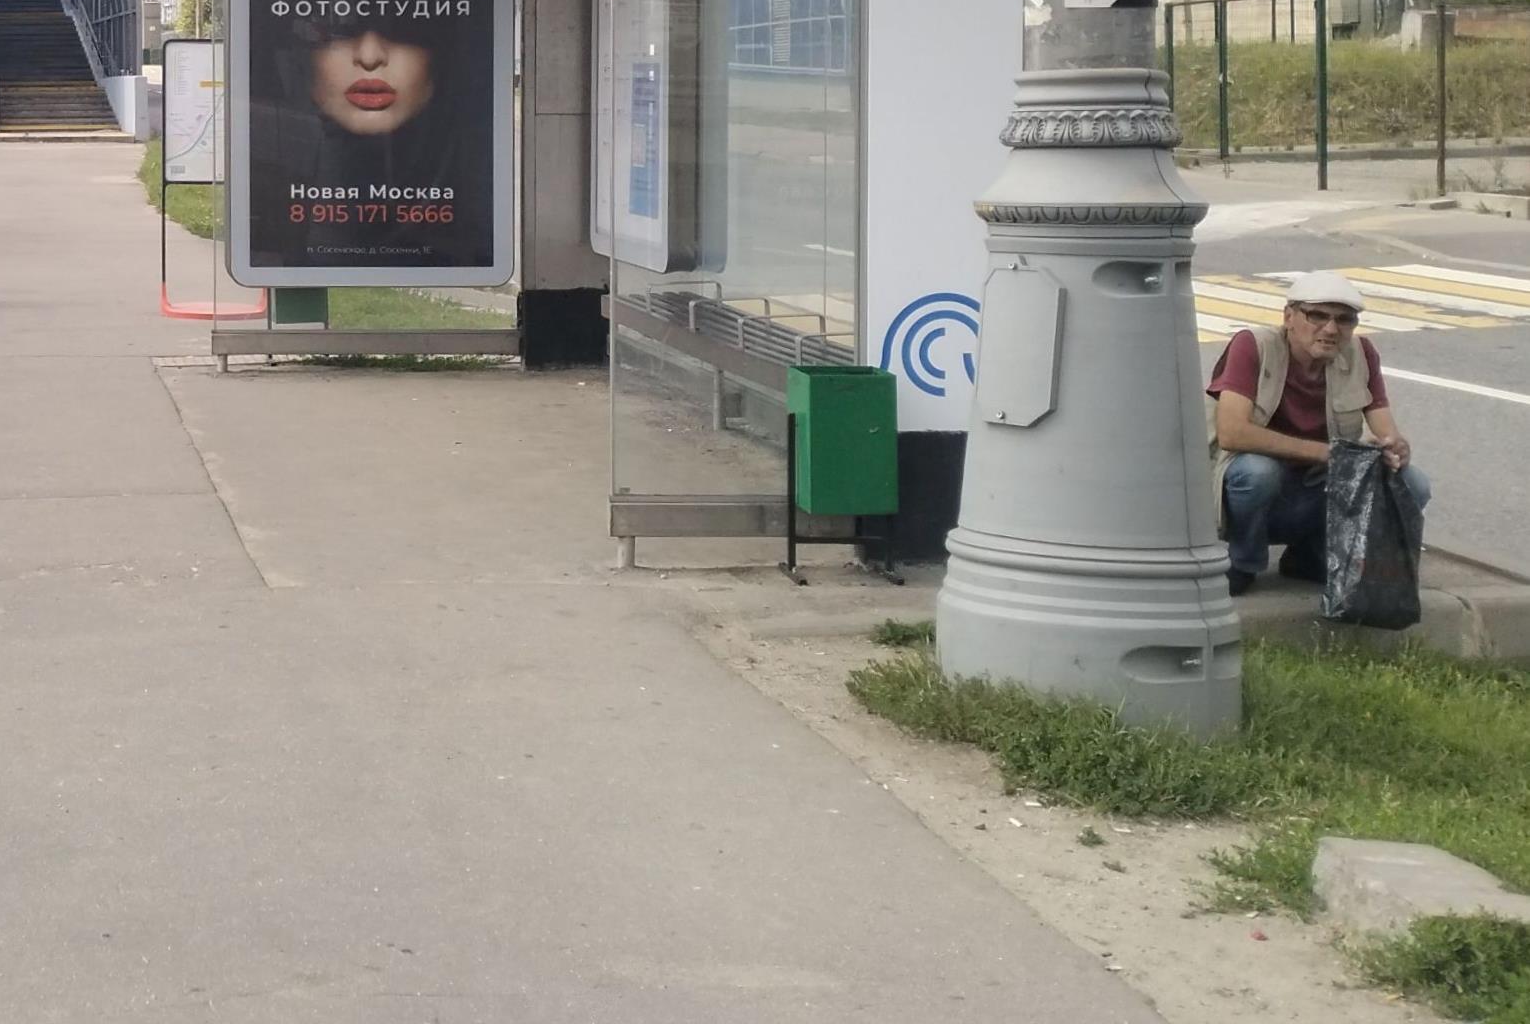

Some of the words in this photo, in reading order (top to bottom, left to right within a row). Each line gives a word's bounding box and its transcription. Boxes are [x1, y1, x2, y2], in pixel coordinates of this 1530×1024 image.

[271, 0, 470, 18] ФОТОСТУДИЯ
[290, 184, 359, 199] Новая
[369, 184, 454, 199] Москва
[289, 204, 305, 223] 8
[312, 204, 349, 223] 915
[355, 204, 387, 223] 171
[396, 204, 454, 223] 5666
